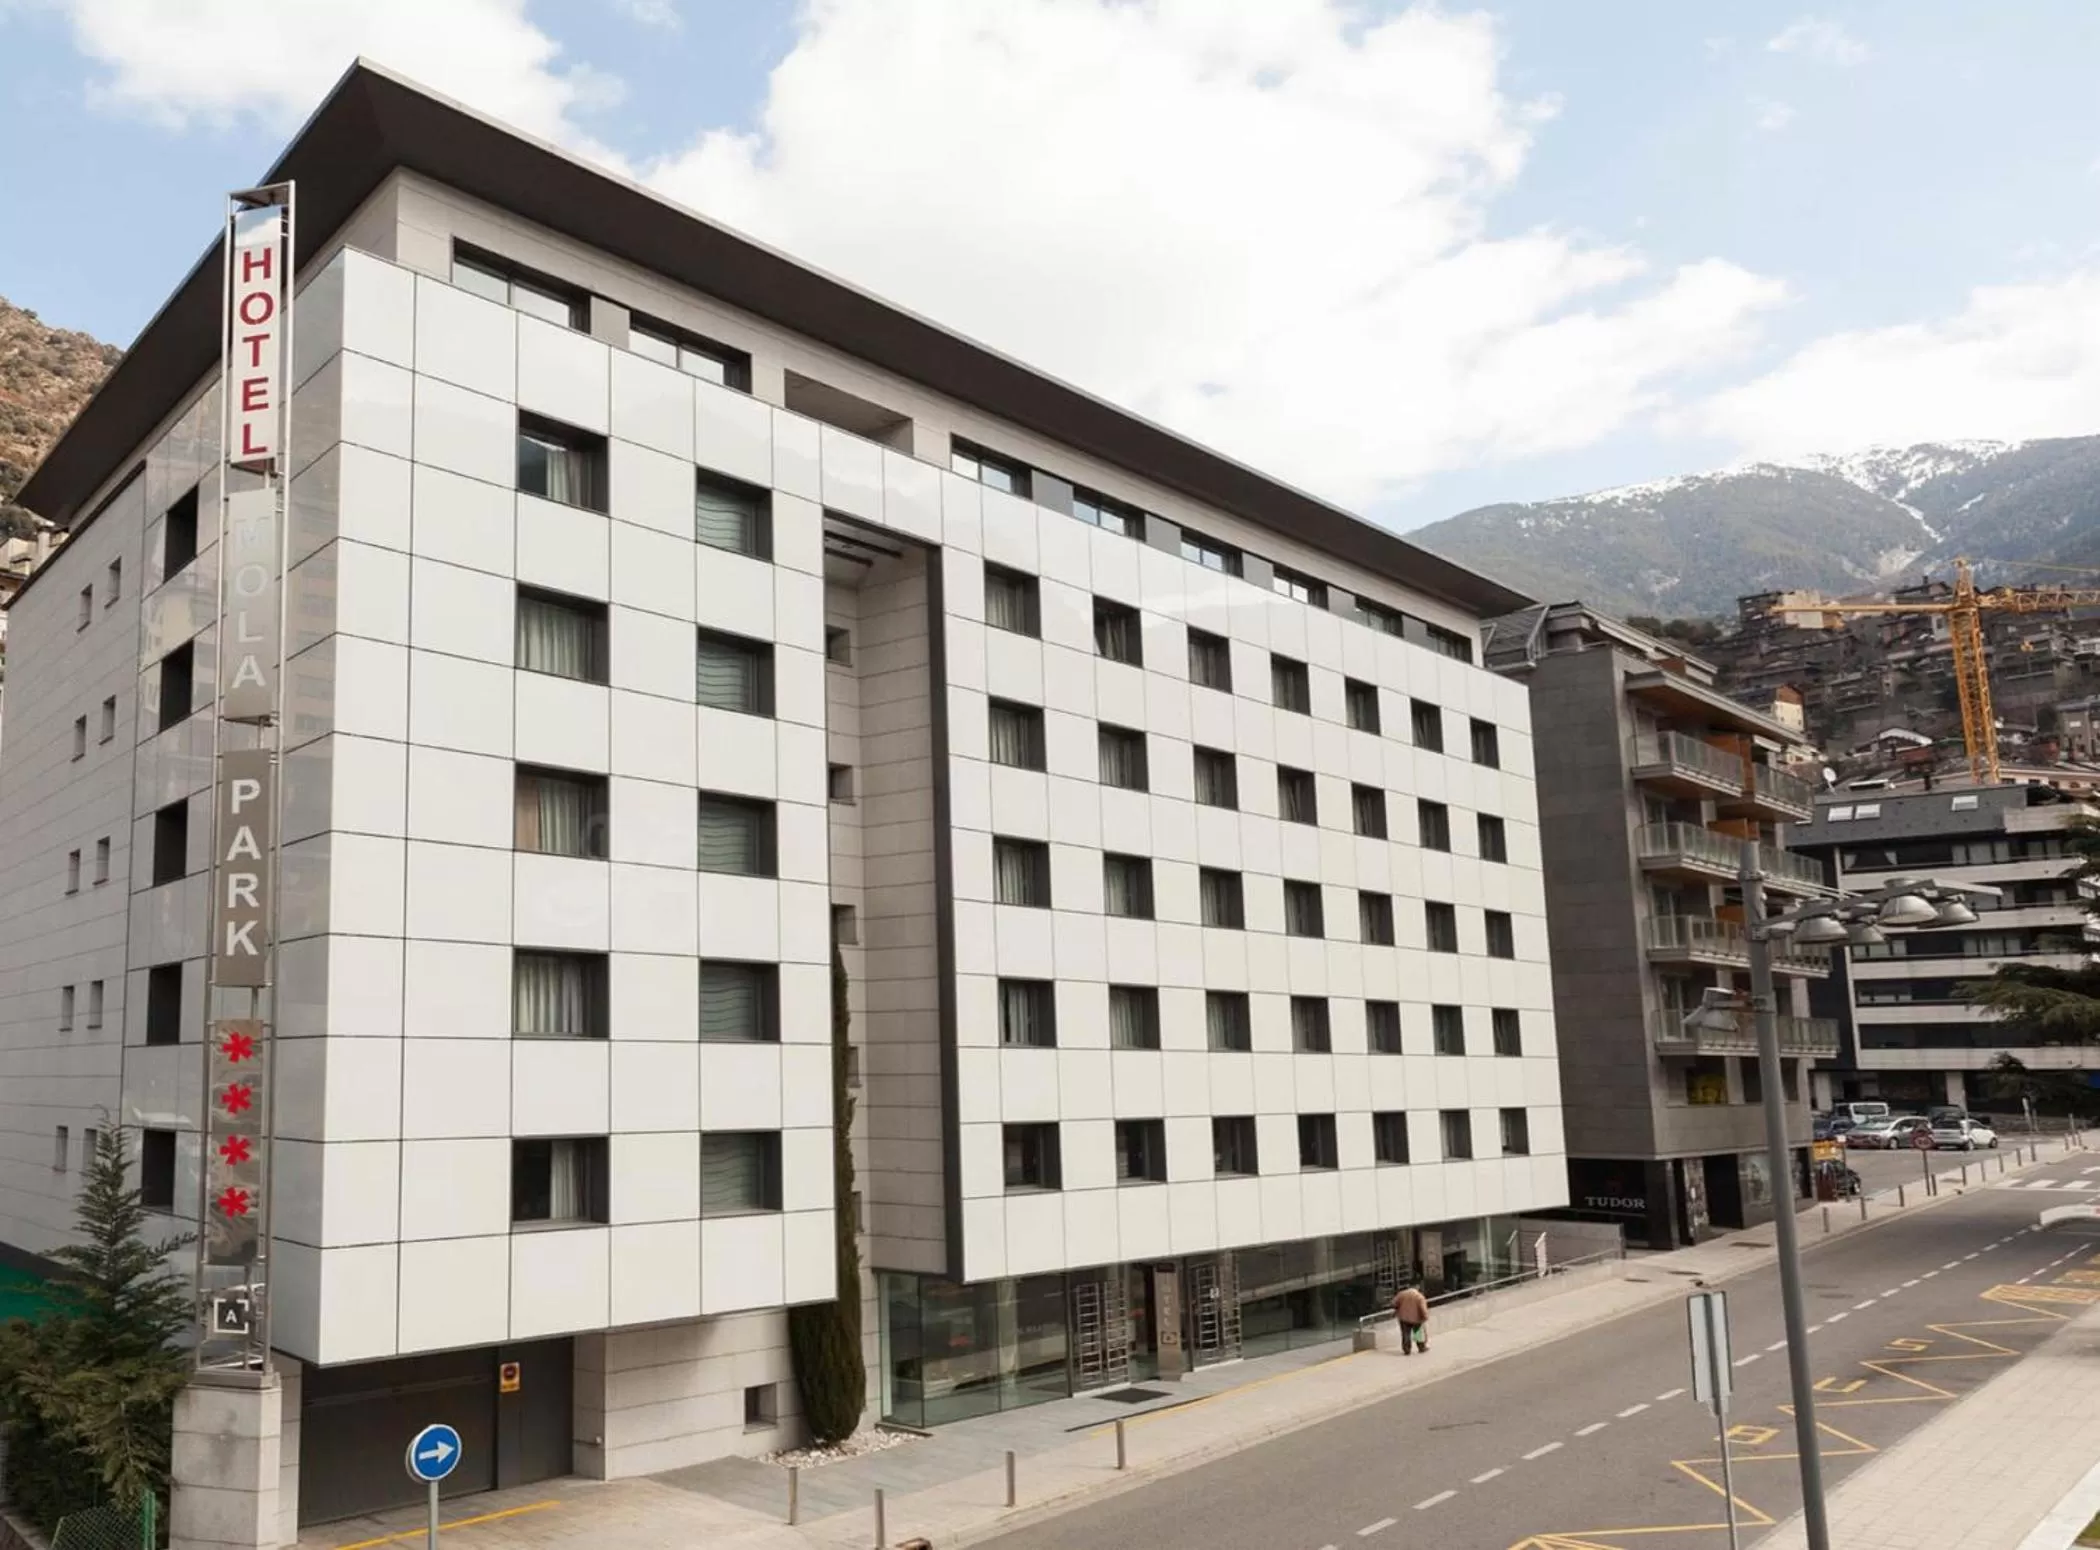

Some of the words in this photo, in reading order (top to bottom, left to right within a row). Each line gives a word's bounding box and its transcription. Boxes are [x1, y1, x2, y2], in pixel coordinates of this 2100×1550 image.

[239, 247, 274, 456] HOTEL
[231, 516, 270, 689] MOLA
[226, 779, 262, 956] PARK
[1584, 1196, 1646, 1209] TUDOR
[1713, 1337, 1936, 1445] BUS
